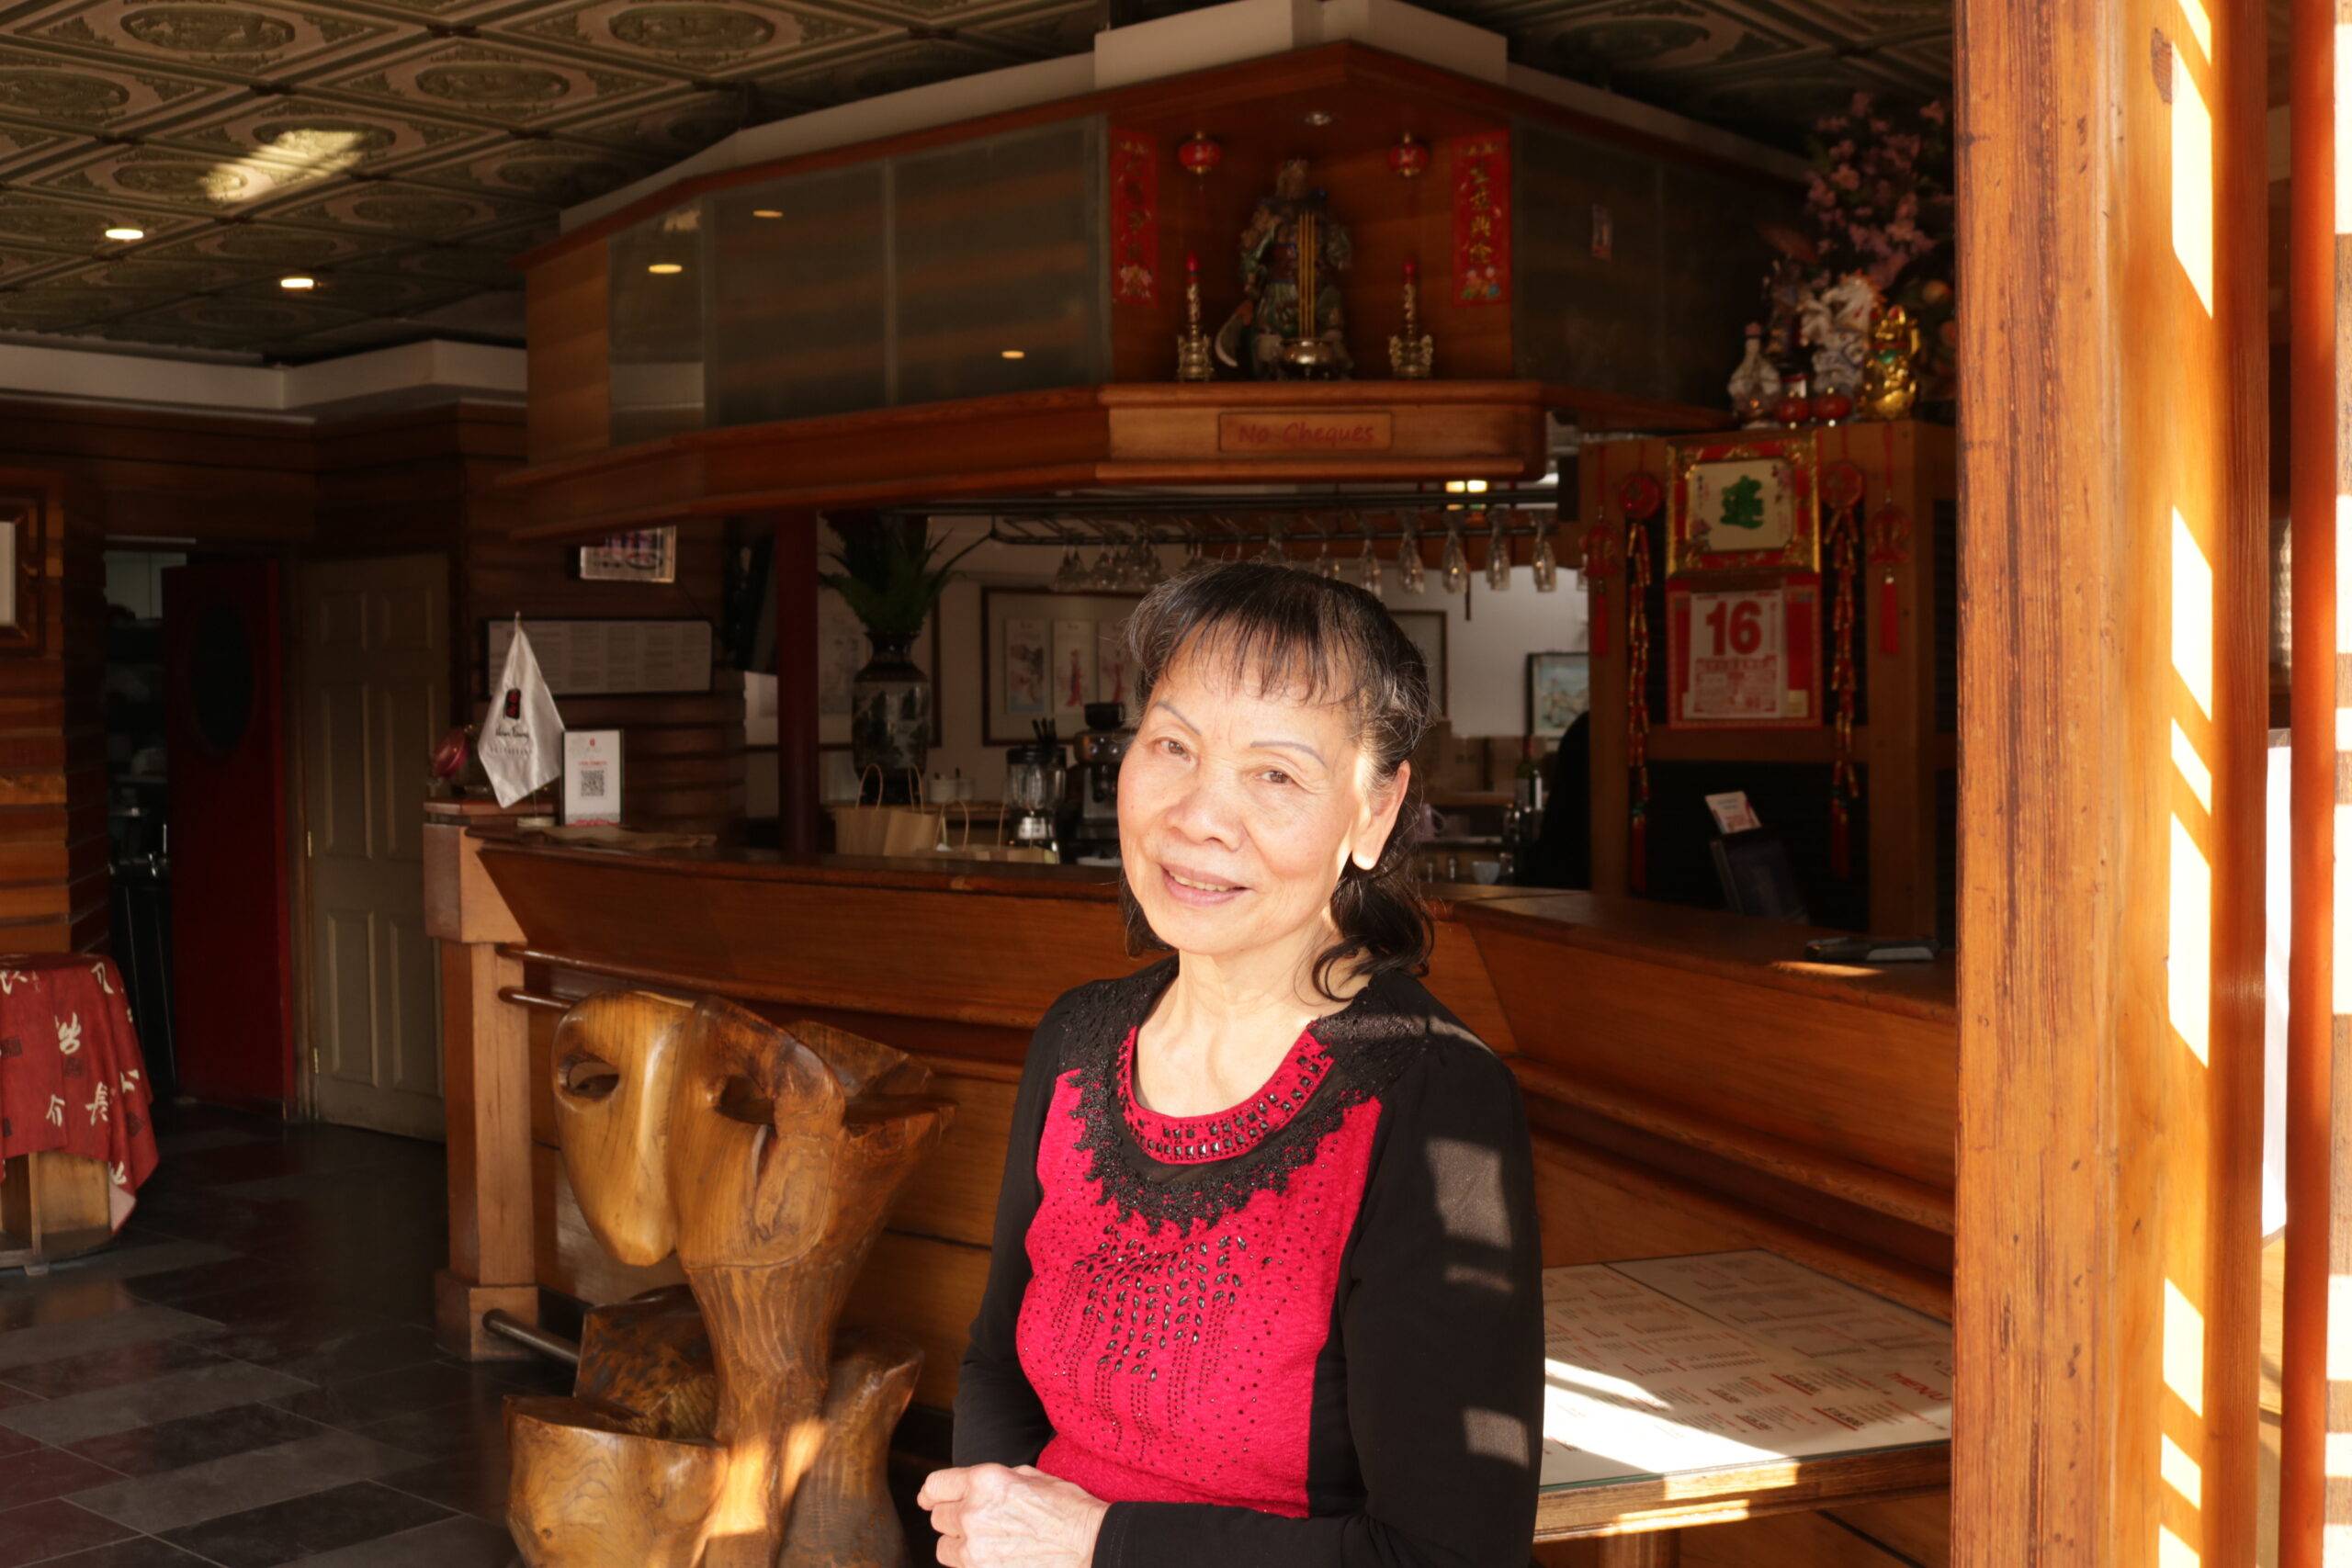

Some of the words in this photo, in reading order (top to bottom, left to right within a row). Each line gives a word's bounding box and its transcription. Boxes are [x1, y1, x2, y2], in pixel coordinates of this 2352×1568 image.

[1238, 423, 1269, 443] No
[1283, 422, 1374, 447] Cheques
[1706, 600, 1762, 656] 16
